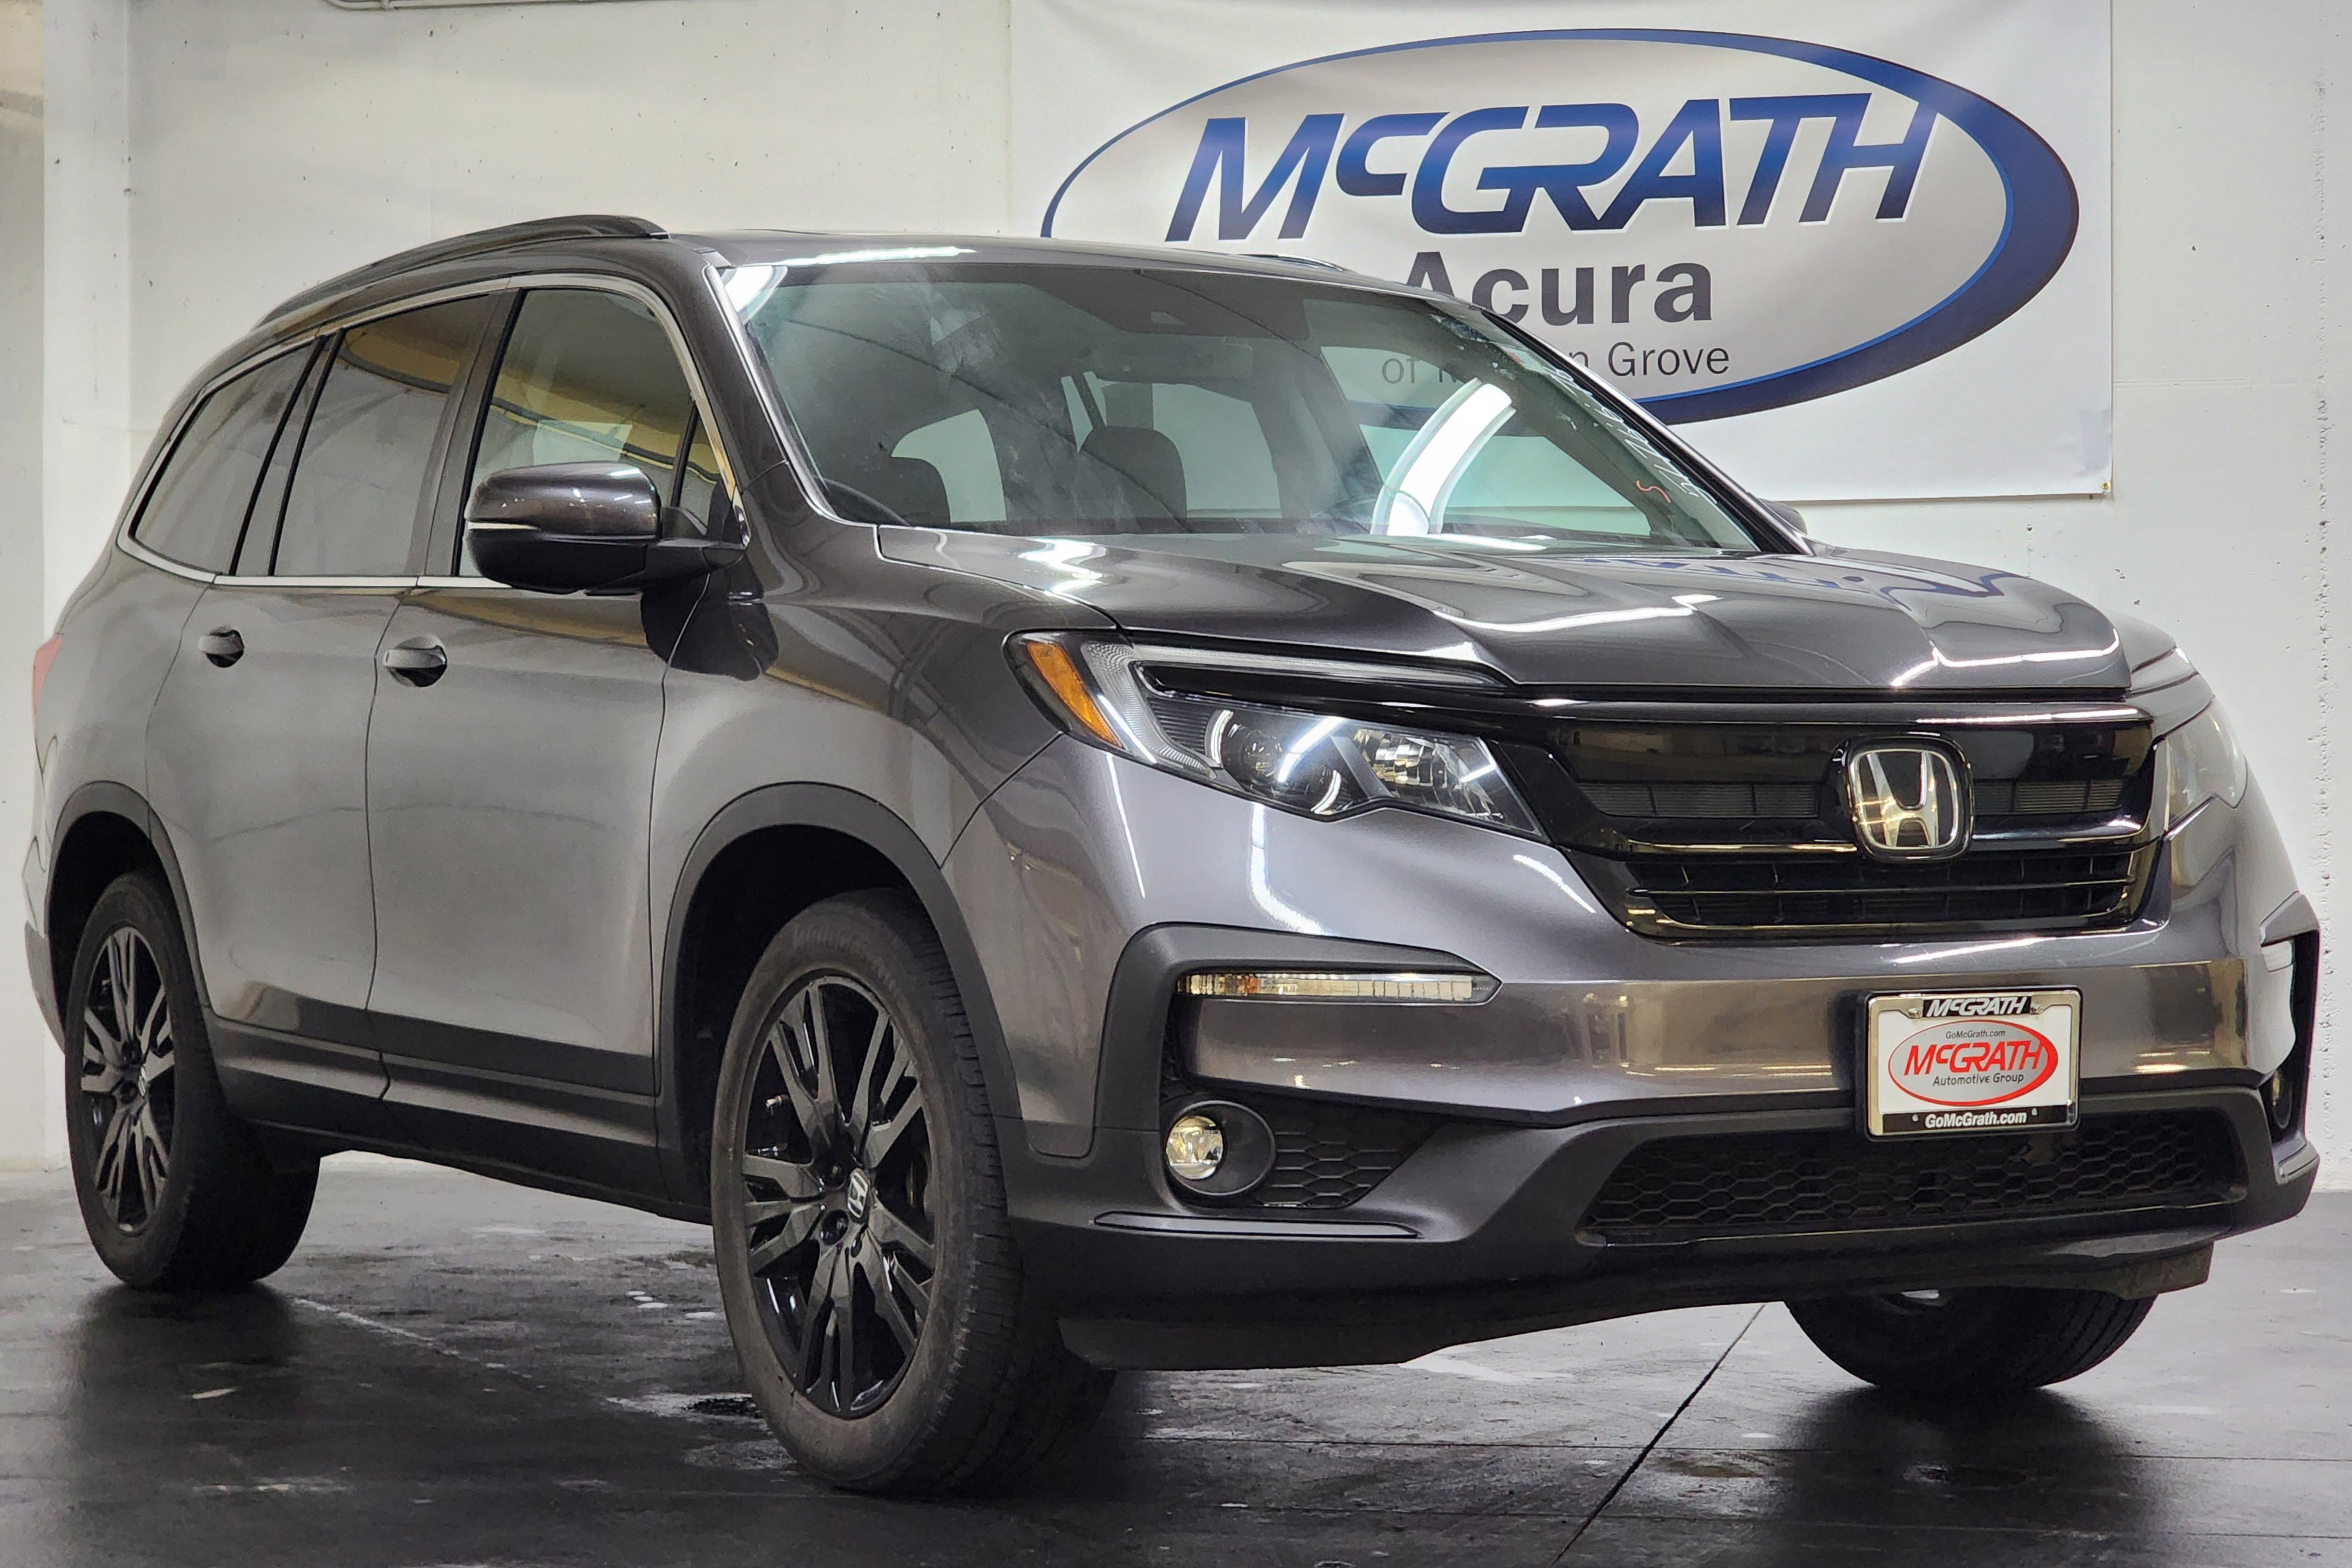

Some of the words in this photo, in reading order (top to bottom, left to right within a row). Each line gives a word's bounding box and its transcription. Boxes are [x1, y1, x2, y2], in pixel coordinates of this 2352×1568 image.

[1406, 251, 1713, 326] Acura
[1608, 341, 1730, 376] Grove
[1945, 1030, 2005, 1039] GoMcGrath.com
[1932, 1074, 1990, 1086] Automotive
[1993, 1073, 2024, 1084] Group
[1925, 1111, 2027, 1128] GoMcGrath.com
